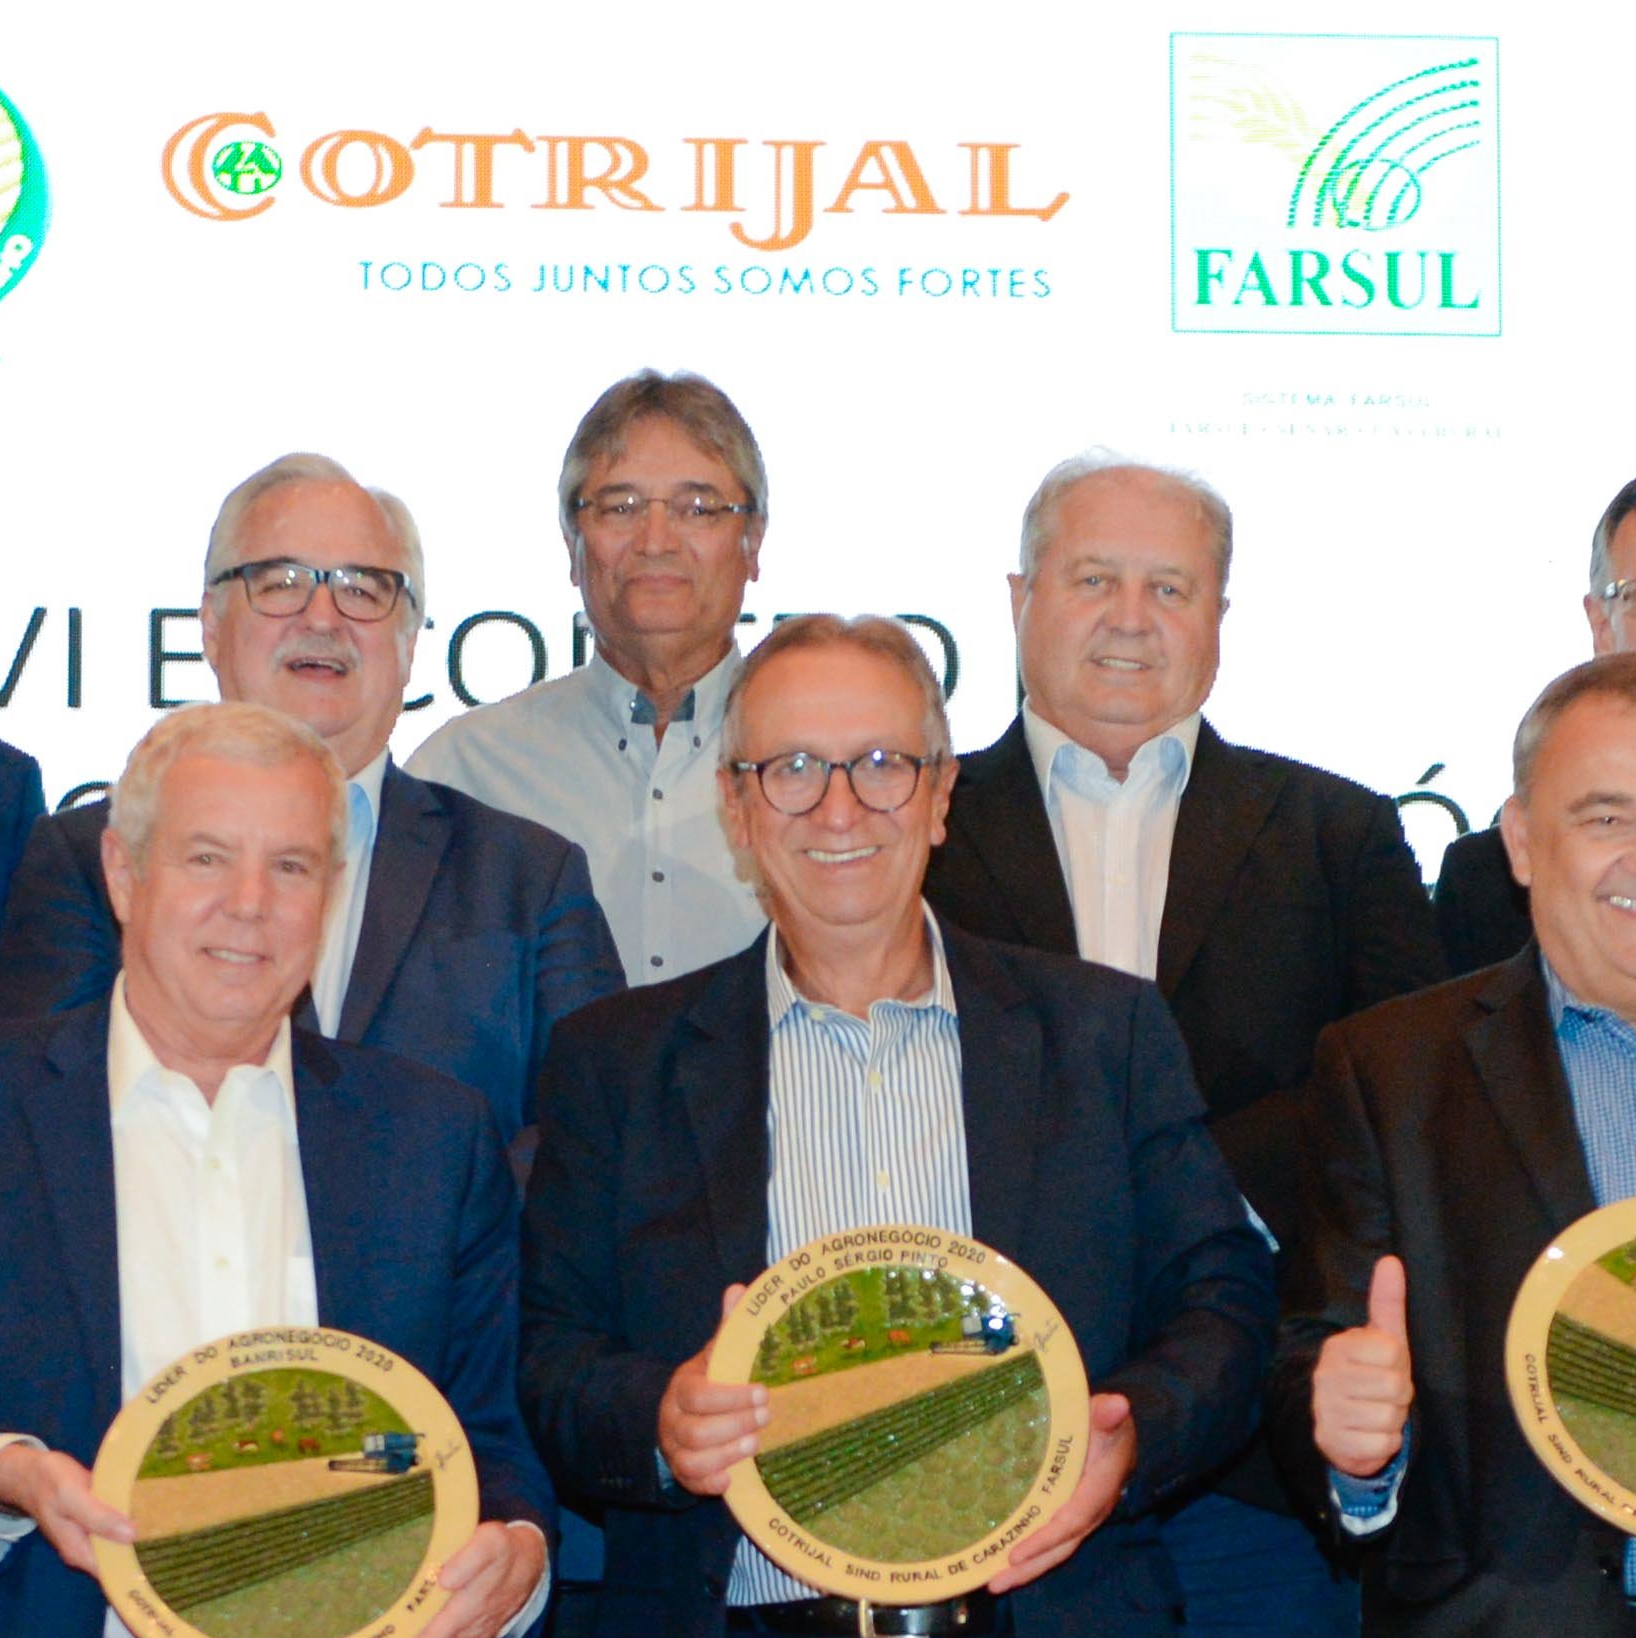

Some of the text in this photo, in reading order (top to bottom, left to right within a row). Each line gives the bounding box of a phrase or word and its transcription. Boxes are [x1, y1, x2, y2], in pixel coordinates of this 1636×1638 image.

[161, 110, 1071, 252] COTRIJAL
[358, 260, 1053, 300] TODOS JUNTOS SOMOS FORTES
[1193, 247, 1482, 310] FARSUL
[779, 1248, 949, 1305] PAULO SÉRGIO PINTO
[788, 1252, 812, 1272] DO
[821, 1230, 942, 1255] AGRONEGÓCIO
[947, 1239, 988, 1265] 2020
[193, 1345, 219, 1366] DO
[354, 1343, 396, 1373] 2020
[768, 1434, 1074, 1584] COTRIJAL SIND RURAL DE CARAZINHO FARSUL
